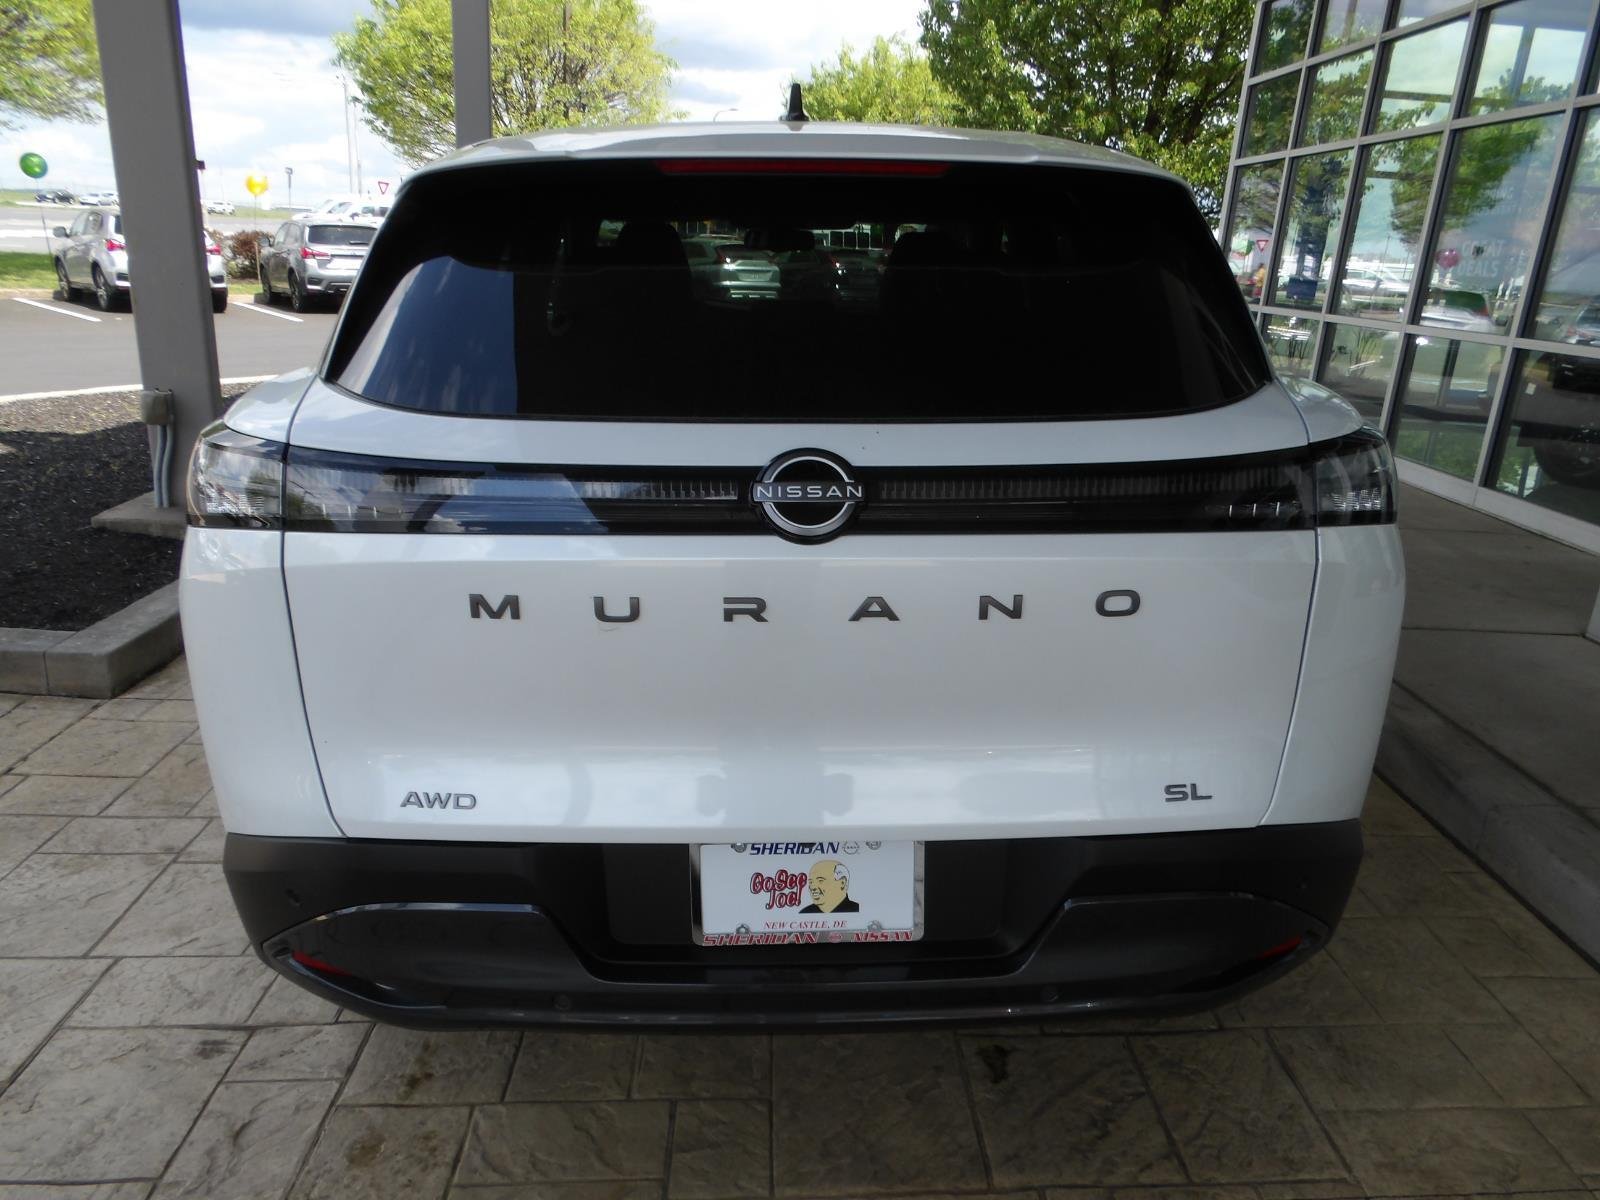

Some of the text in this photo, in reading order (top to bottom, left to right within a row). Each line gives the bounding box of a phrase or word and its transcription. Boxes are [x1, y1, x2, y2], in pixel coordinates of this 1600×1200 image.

[757, 485, 863, 498] NISSAN
[469, 589, 1141, 623] MURANO
[400, 791, 477, 810] AWD
[1164, 783, 1213, 802] SL
[749, 842, 840, 855] SHERIDAN
[750, 869, 807, 894] Go See
[763, 921, 788, 930] NEW
[832, 920, 848, 929] DE
[702, 931, 912, 946] SHERIDAN NISSAN
